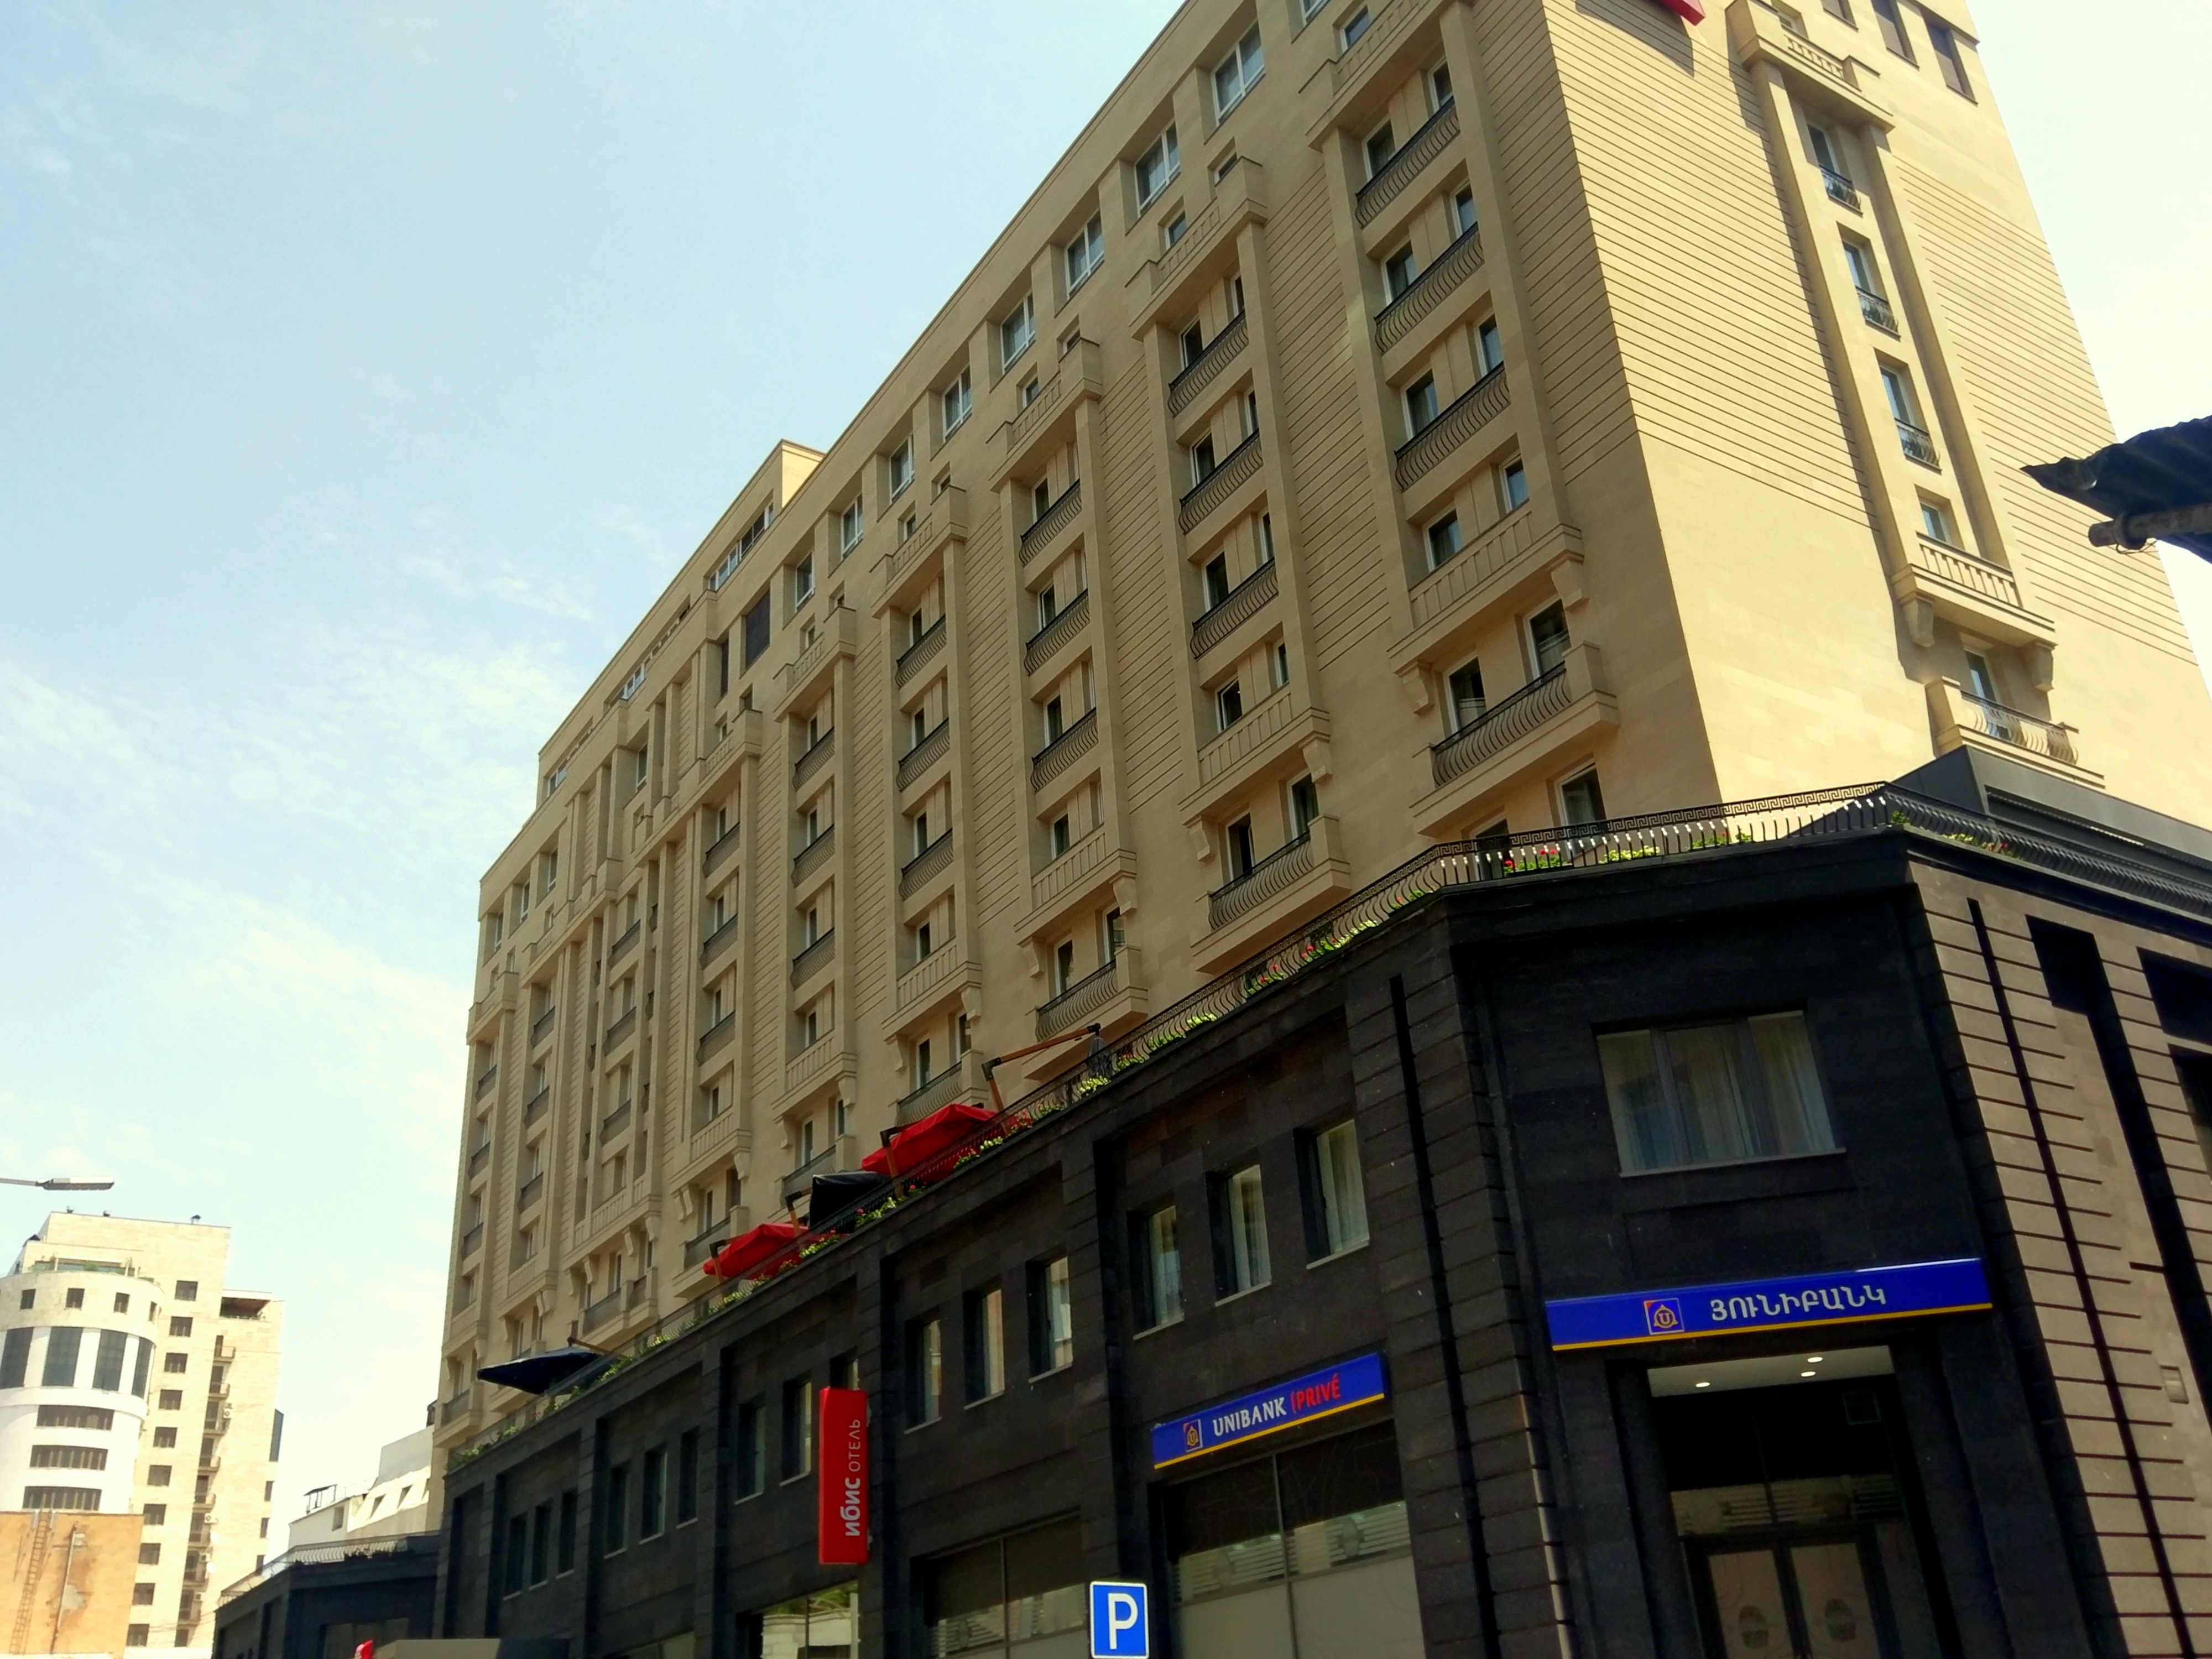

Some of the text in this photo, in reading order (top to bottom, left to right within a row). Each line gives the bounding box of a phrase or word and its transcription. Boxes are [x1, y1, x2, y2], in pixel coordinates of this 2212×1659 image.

[1710, 1285, 1887, 1321] ՅՈՒՆԻԲԱՆԿ
[1212, 1397, 1287, 1437] UNIBANK
[839, 1420, 861, 1536] ибис ОТЕЛЬ
[1108, 1593, 1139, 1650] P
